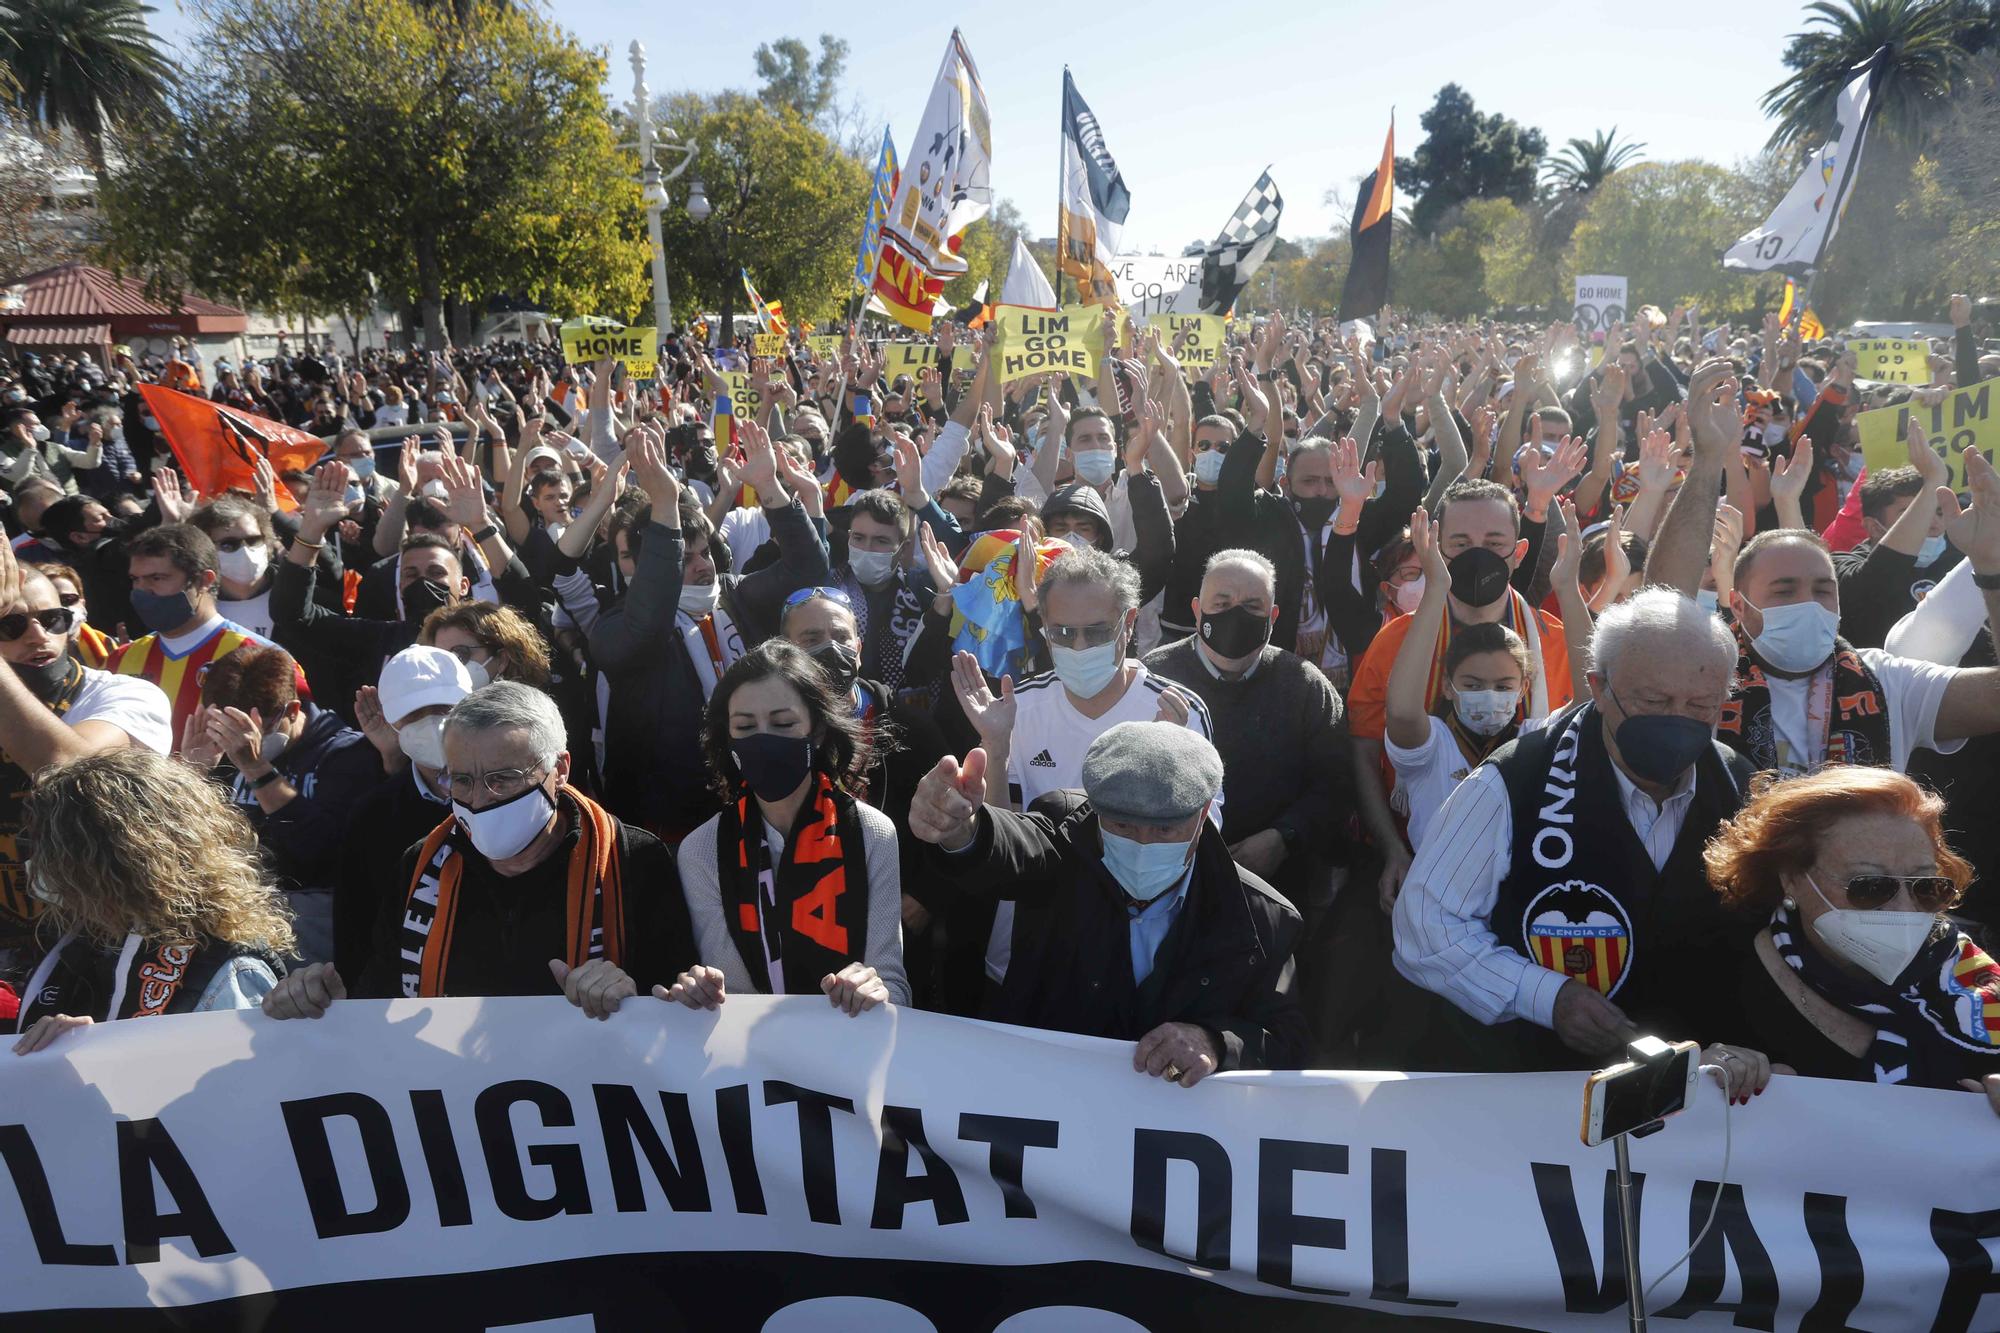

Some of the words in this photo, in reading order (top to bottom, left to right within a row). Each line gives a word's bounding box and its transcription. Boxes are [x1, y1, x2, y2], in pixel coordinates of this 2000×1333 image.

[1164, 264, 1198, 284] ARE
[1132, 282, 1178, 317] 99%
[1580, 287, 1594, 299] GO
[1596, 287, 1622, 299] HOME
[1022, 315, 1069, 335] LIM
[576, 338, 643, 357] HOME
[1025, 335, 1066, 351] GO
[1859, 342, 1918, 351] HOME
[1006, 350, 1086, 374] HOME
[1177, 348, 1214, 362] OME
[1878, 355, 1905, 365] GO
[1873, 370, 1909, 381] LIM
[734, 391, 760, 404] GO
[1929, 429, 1976, 459] GO
[1029, 759, 1057, 768] adidas
[1532, 926, 1595, 937] VALENCIA
[1598, 927, 1623, 937] C.F.
[0, 1117, 237, 1265] LA
[280, 1079, 1059, 1239] DIGNITAT
[1131, 1127, 1460, 1308] DEL
